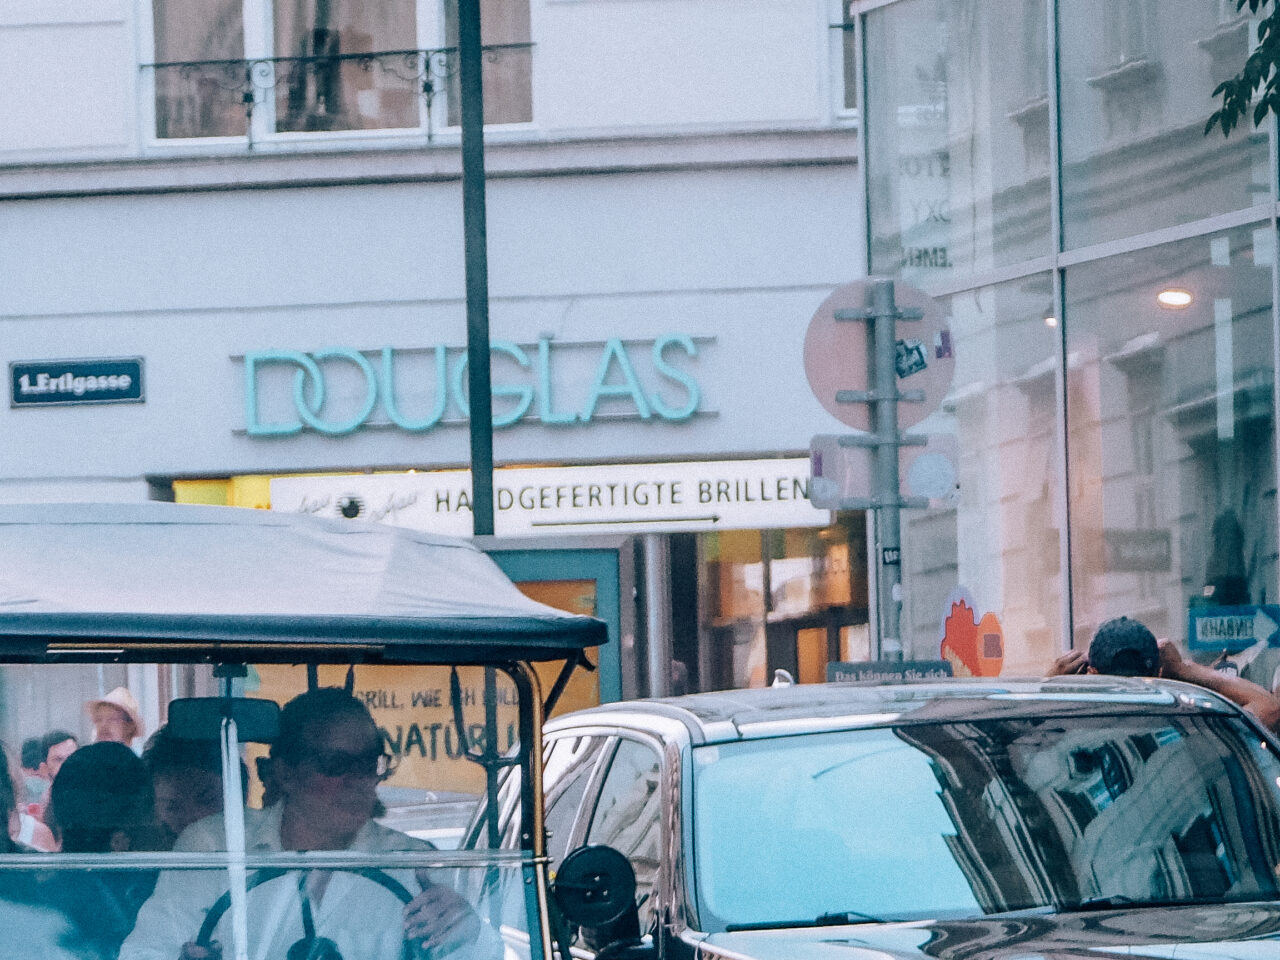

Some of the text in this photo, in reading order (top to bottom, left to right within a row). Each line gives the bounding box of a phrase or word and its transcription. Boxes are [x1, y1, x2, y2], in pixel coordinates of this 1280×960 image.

[245, 333, 703, 435] DOUGLAS
[436, 482, 683, 513] HADGEFERTIGTE
[698, 477, 810, 504] BRILLEN
[859, 669, 903, 681] können
[905, 669, 922, 680] Sie
[925, 669, 948, 679] sich
[411, 688, 442, 707] WIE
